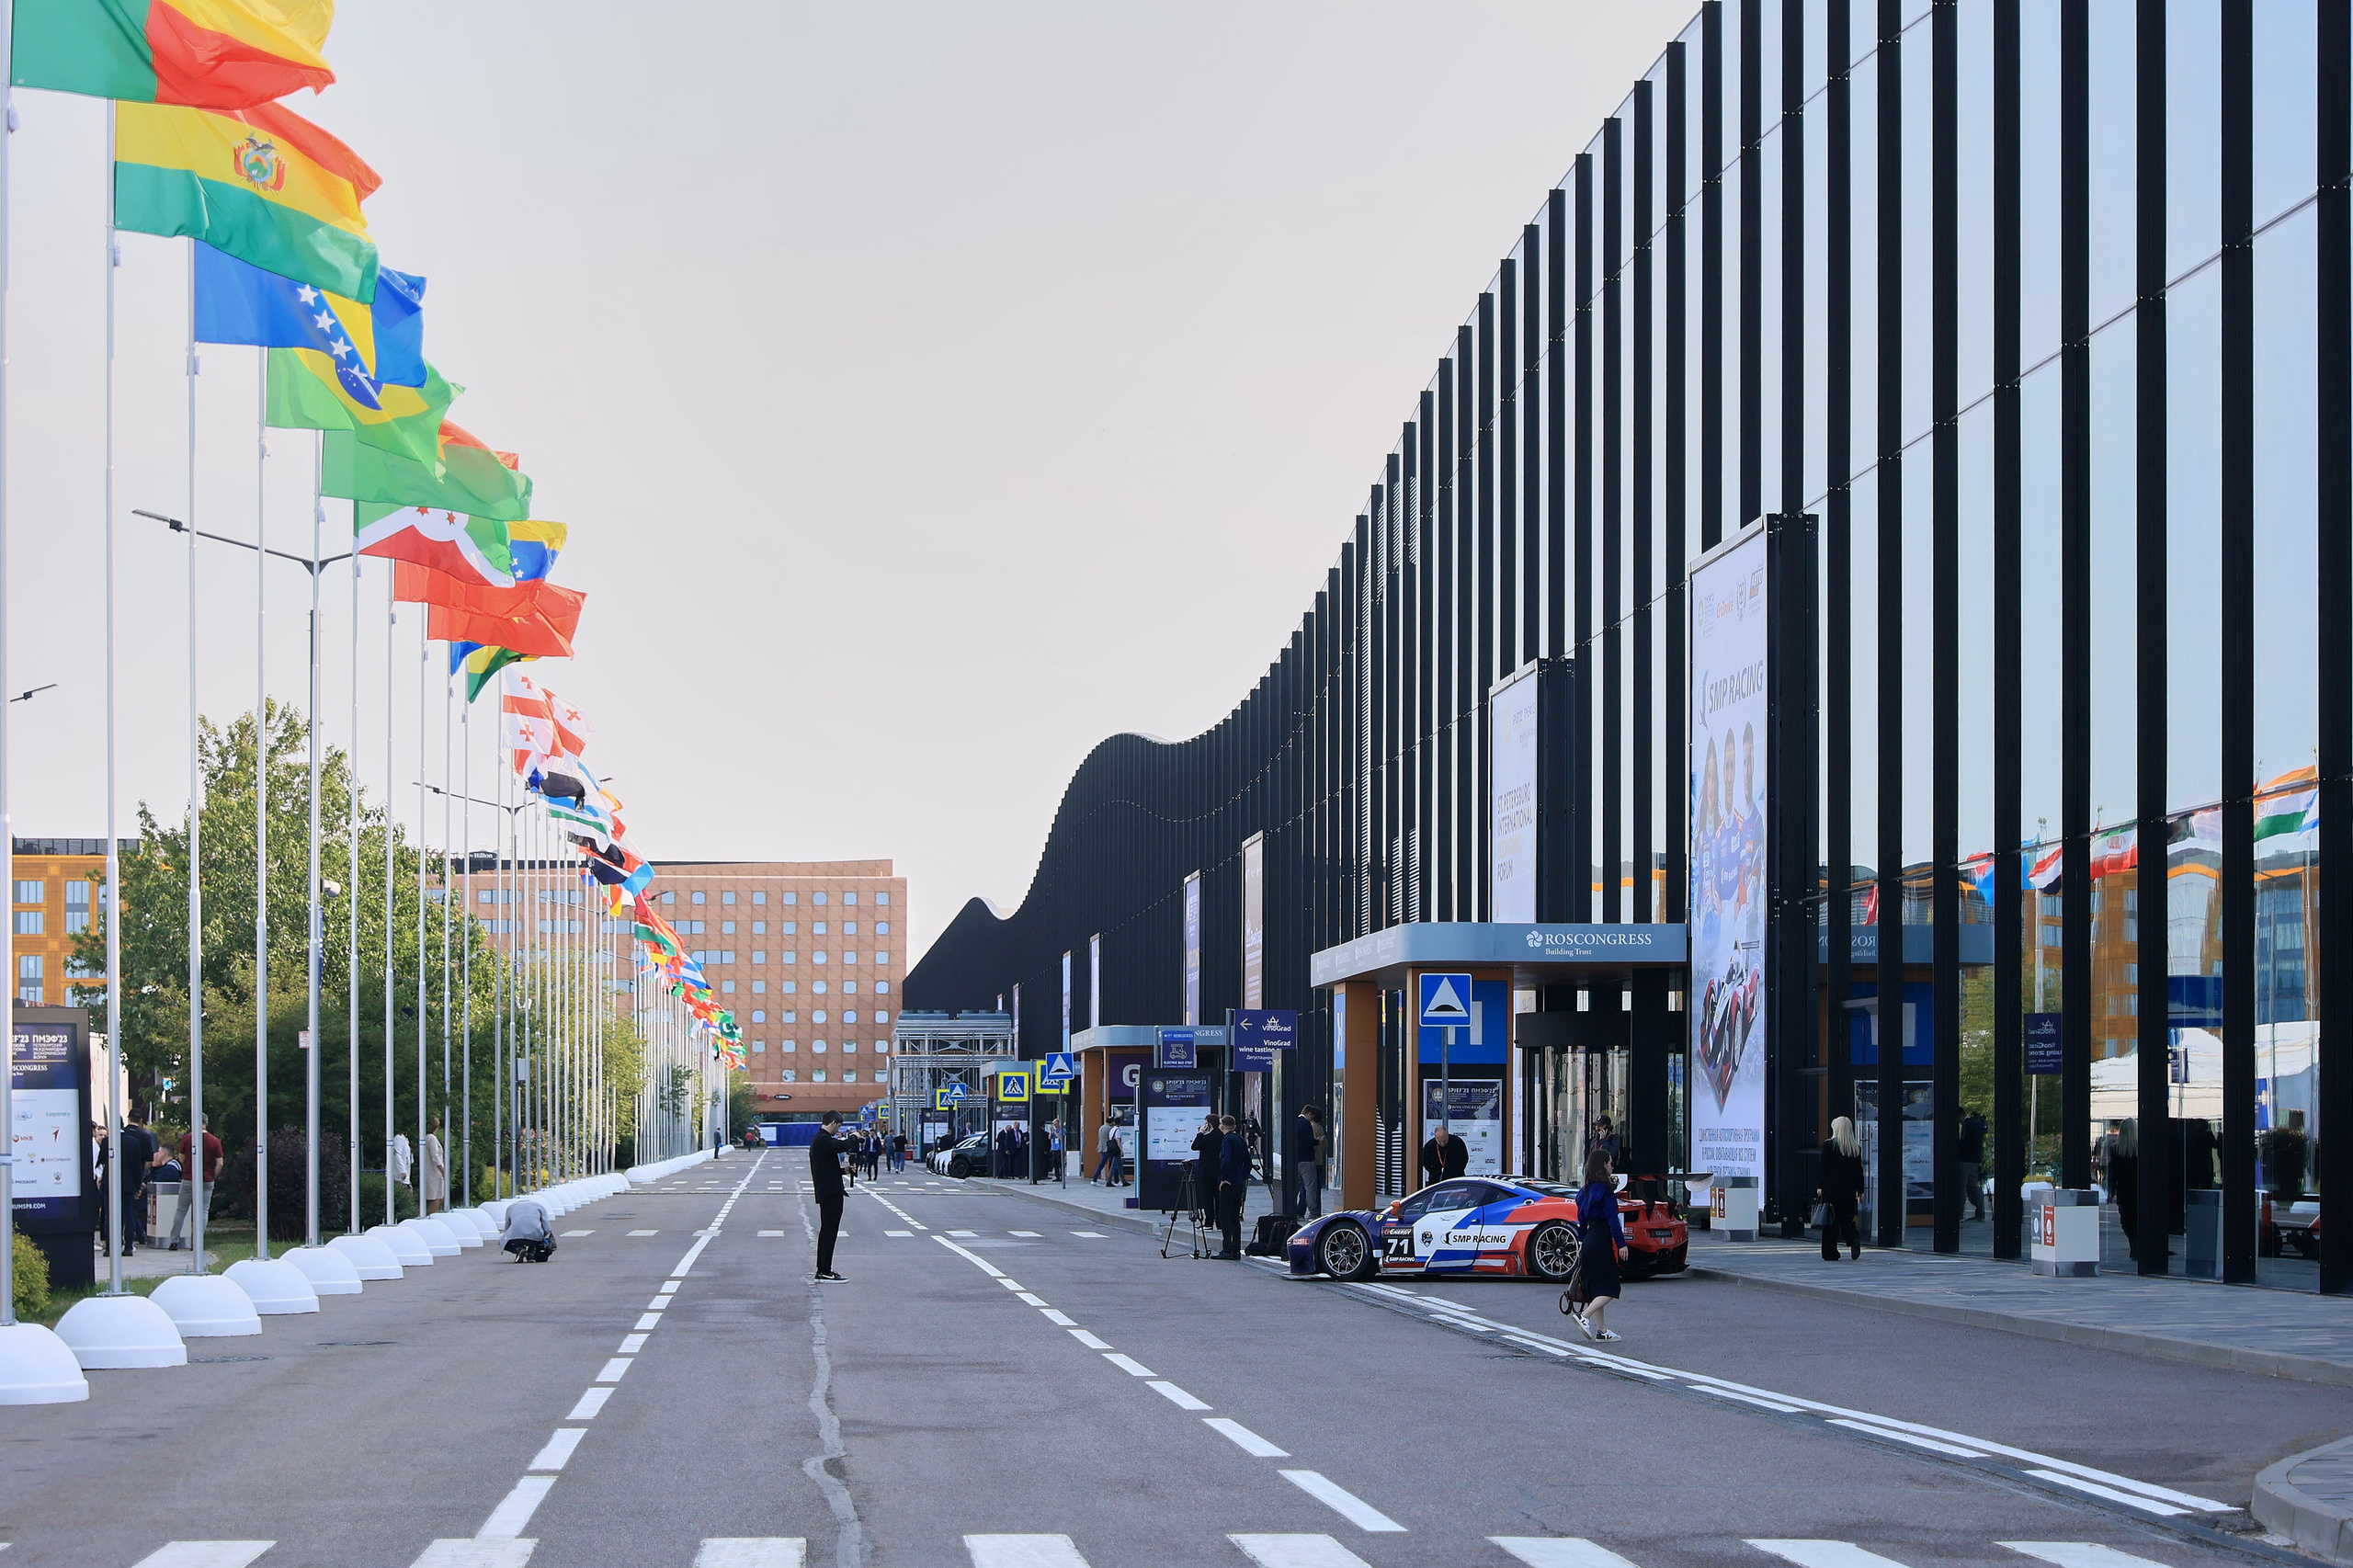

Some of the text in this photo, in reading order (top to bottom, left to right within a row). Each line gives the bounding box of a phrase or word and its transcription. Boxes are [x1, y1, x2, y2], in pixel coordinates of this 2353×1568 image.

[1709, 660, 1764, 714] SMP RACING
[1497, 804, 1533, 837] INTERNATIONAL
[1497, 858, 1514, 882] FORUM
[1545, 933, 1652, 946] ROSCONGRESS
[1546, 948, 1574, 957] Building
[32, 1034, 68, 1043] ПМЭФ'23
[1122, 1063, 1141, 1087] G
[1388, 1239, 1409, 1255] 71
[1472, 1235, 1506, 1244] RACING
